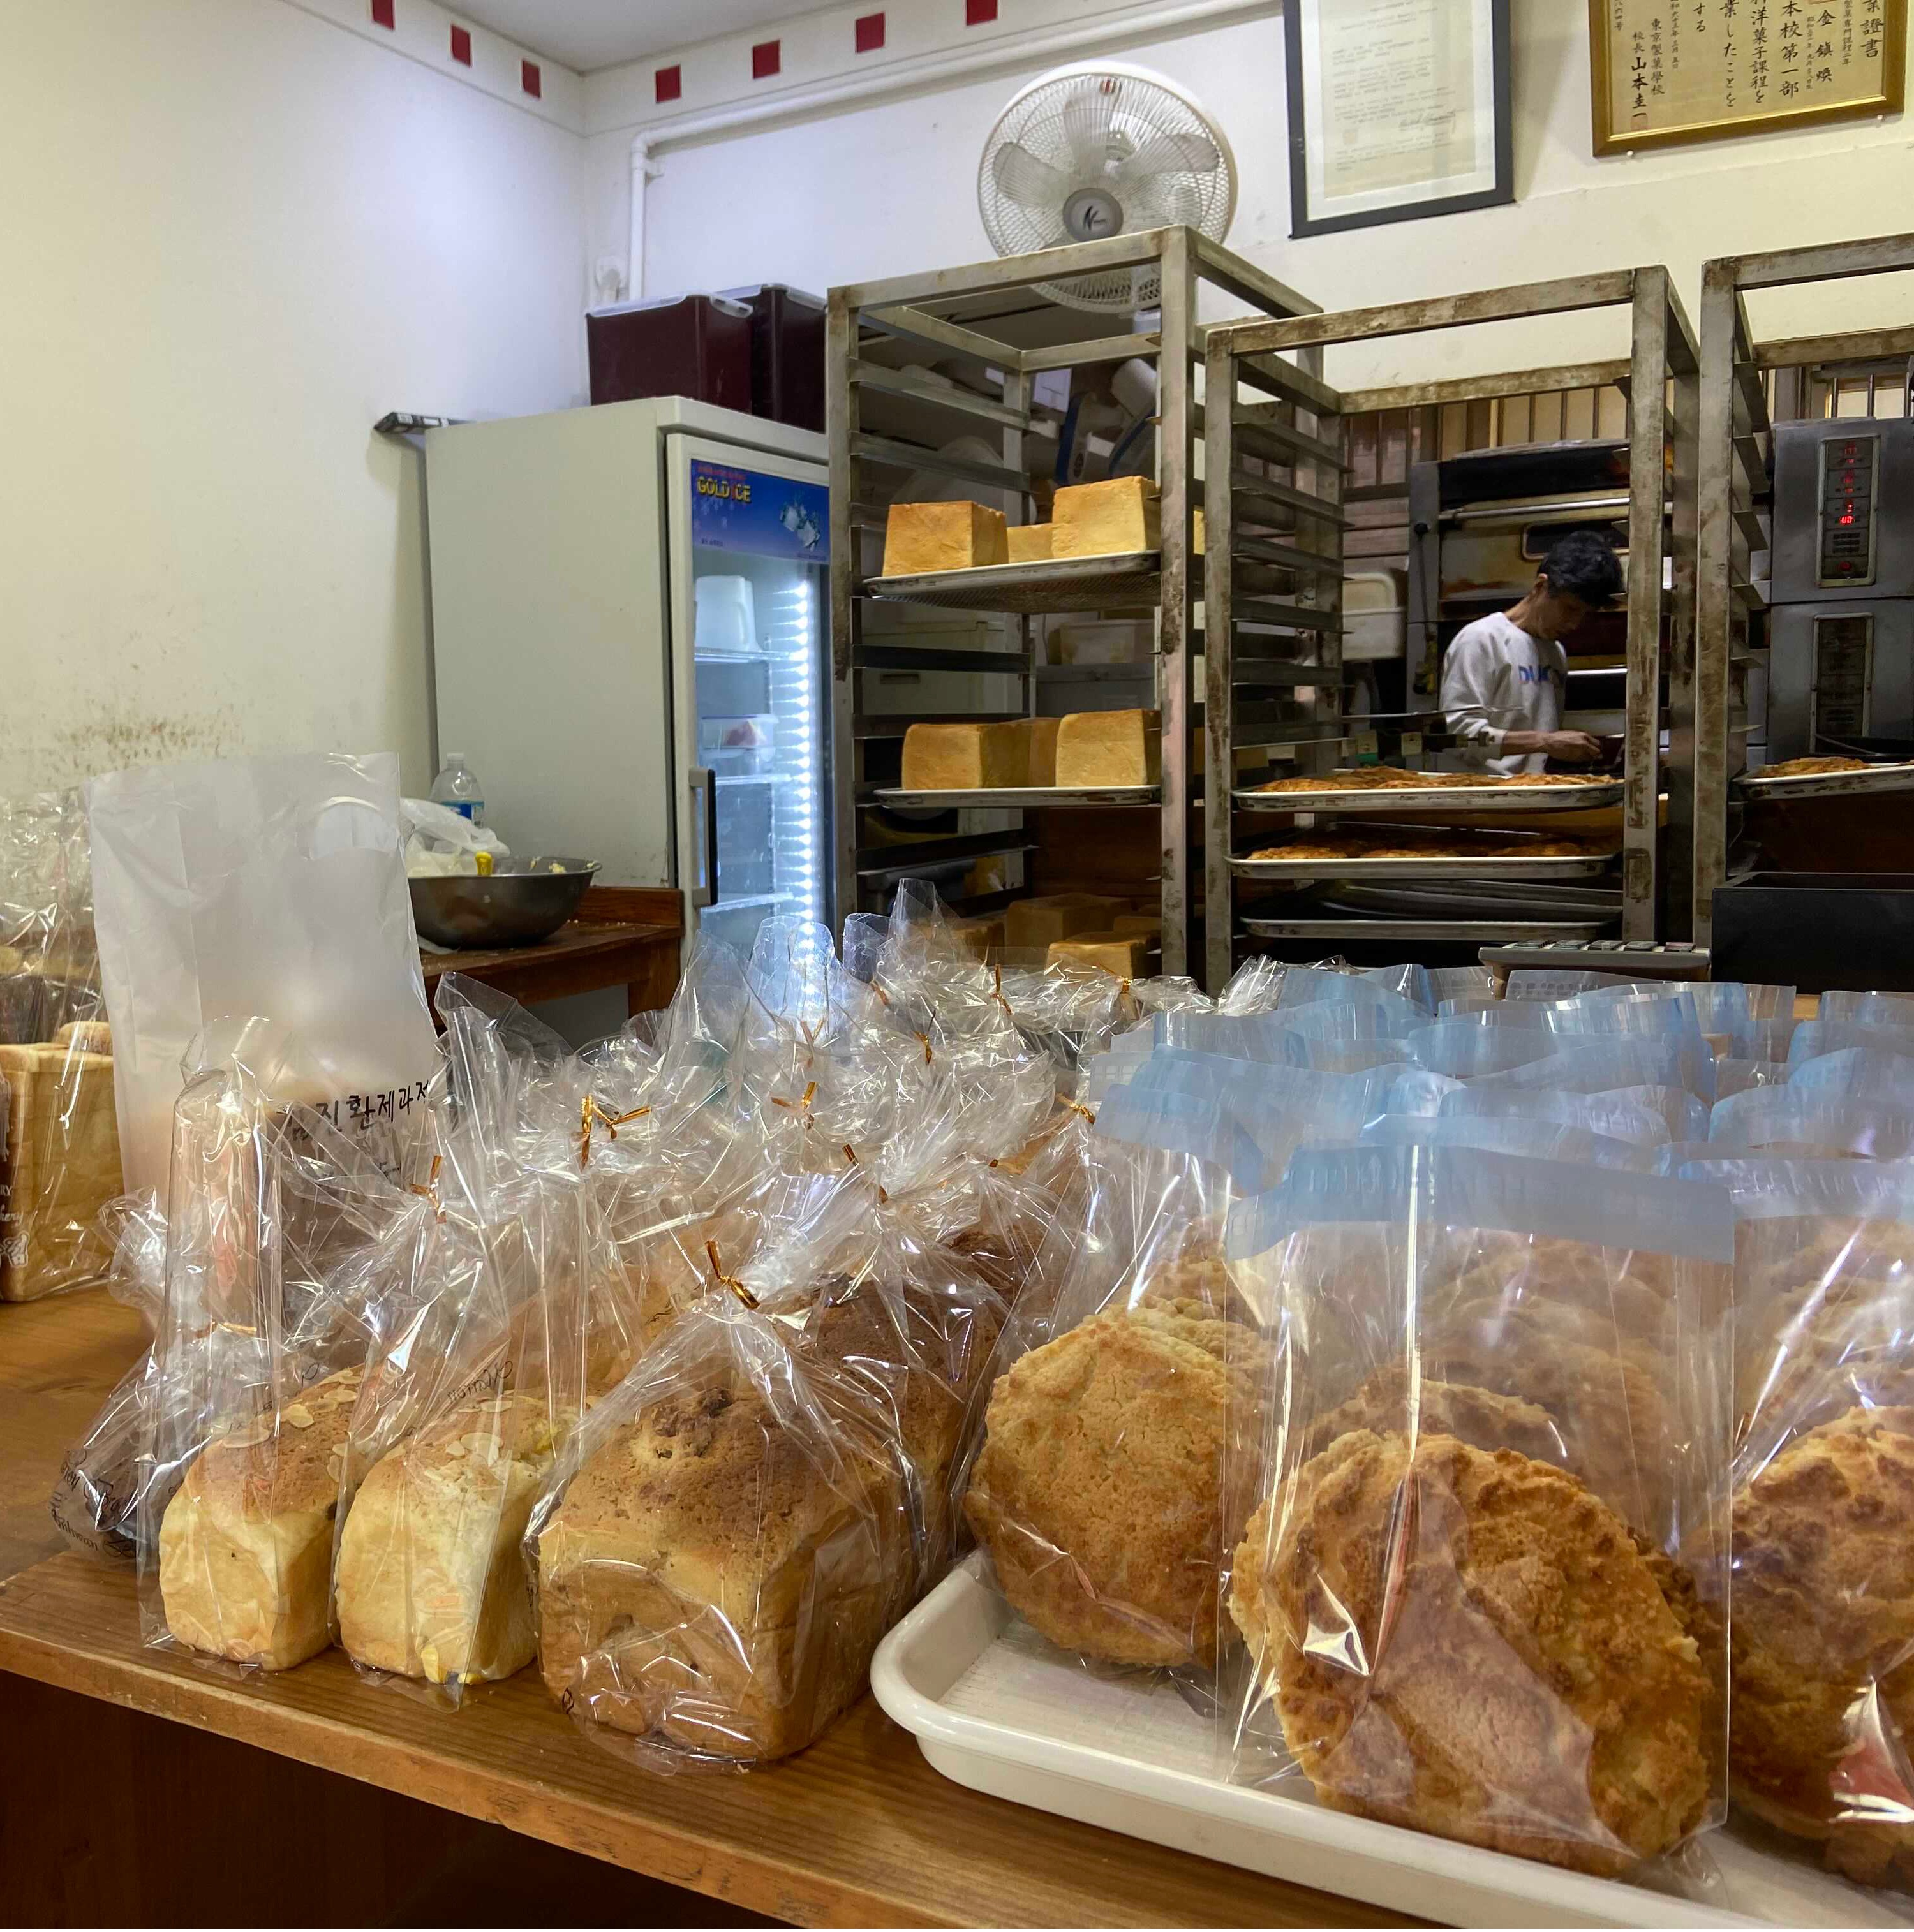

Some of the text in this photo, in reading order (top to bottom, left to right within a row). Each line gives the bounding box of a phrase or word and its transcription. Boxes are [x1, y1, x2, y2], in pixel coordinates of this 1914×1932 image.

[1693, 3, 1706, 32] する
[1749, 0, 1770, 103] 洋菓子課程を
[697, 476, 731, 498] GOLD
